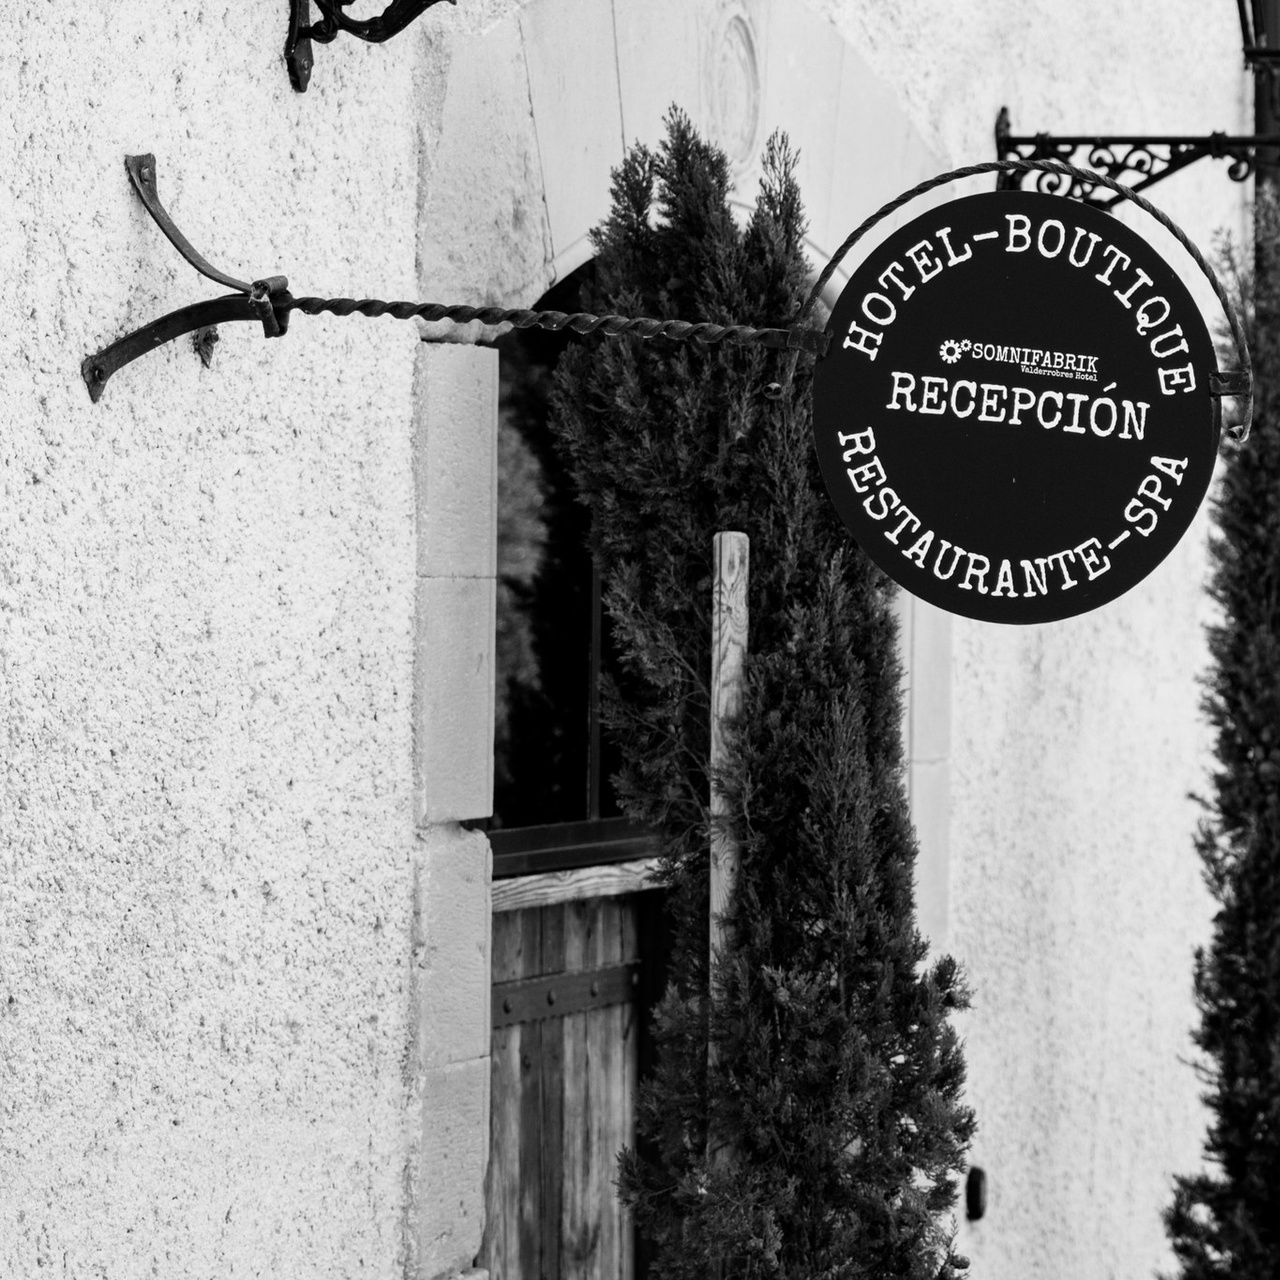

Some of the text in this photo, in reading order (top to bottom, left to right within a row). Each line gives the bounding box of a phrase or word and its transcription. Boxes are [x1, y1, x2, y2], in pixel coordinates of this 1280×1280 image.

[971, 342, 1099, 373] SOMNIFABRIK
[1020, 365, 1098, 382] Valderrobres Hotel
[885, 371, 1151, 441] RECEPCIÓN
